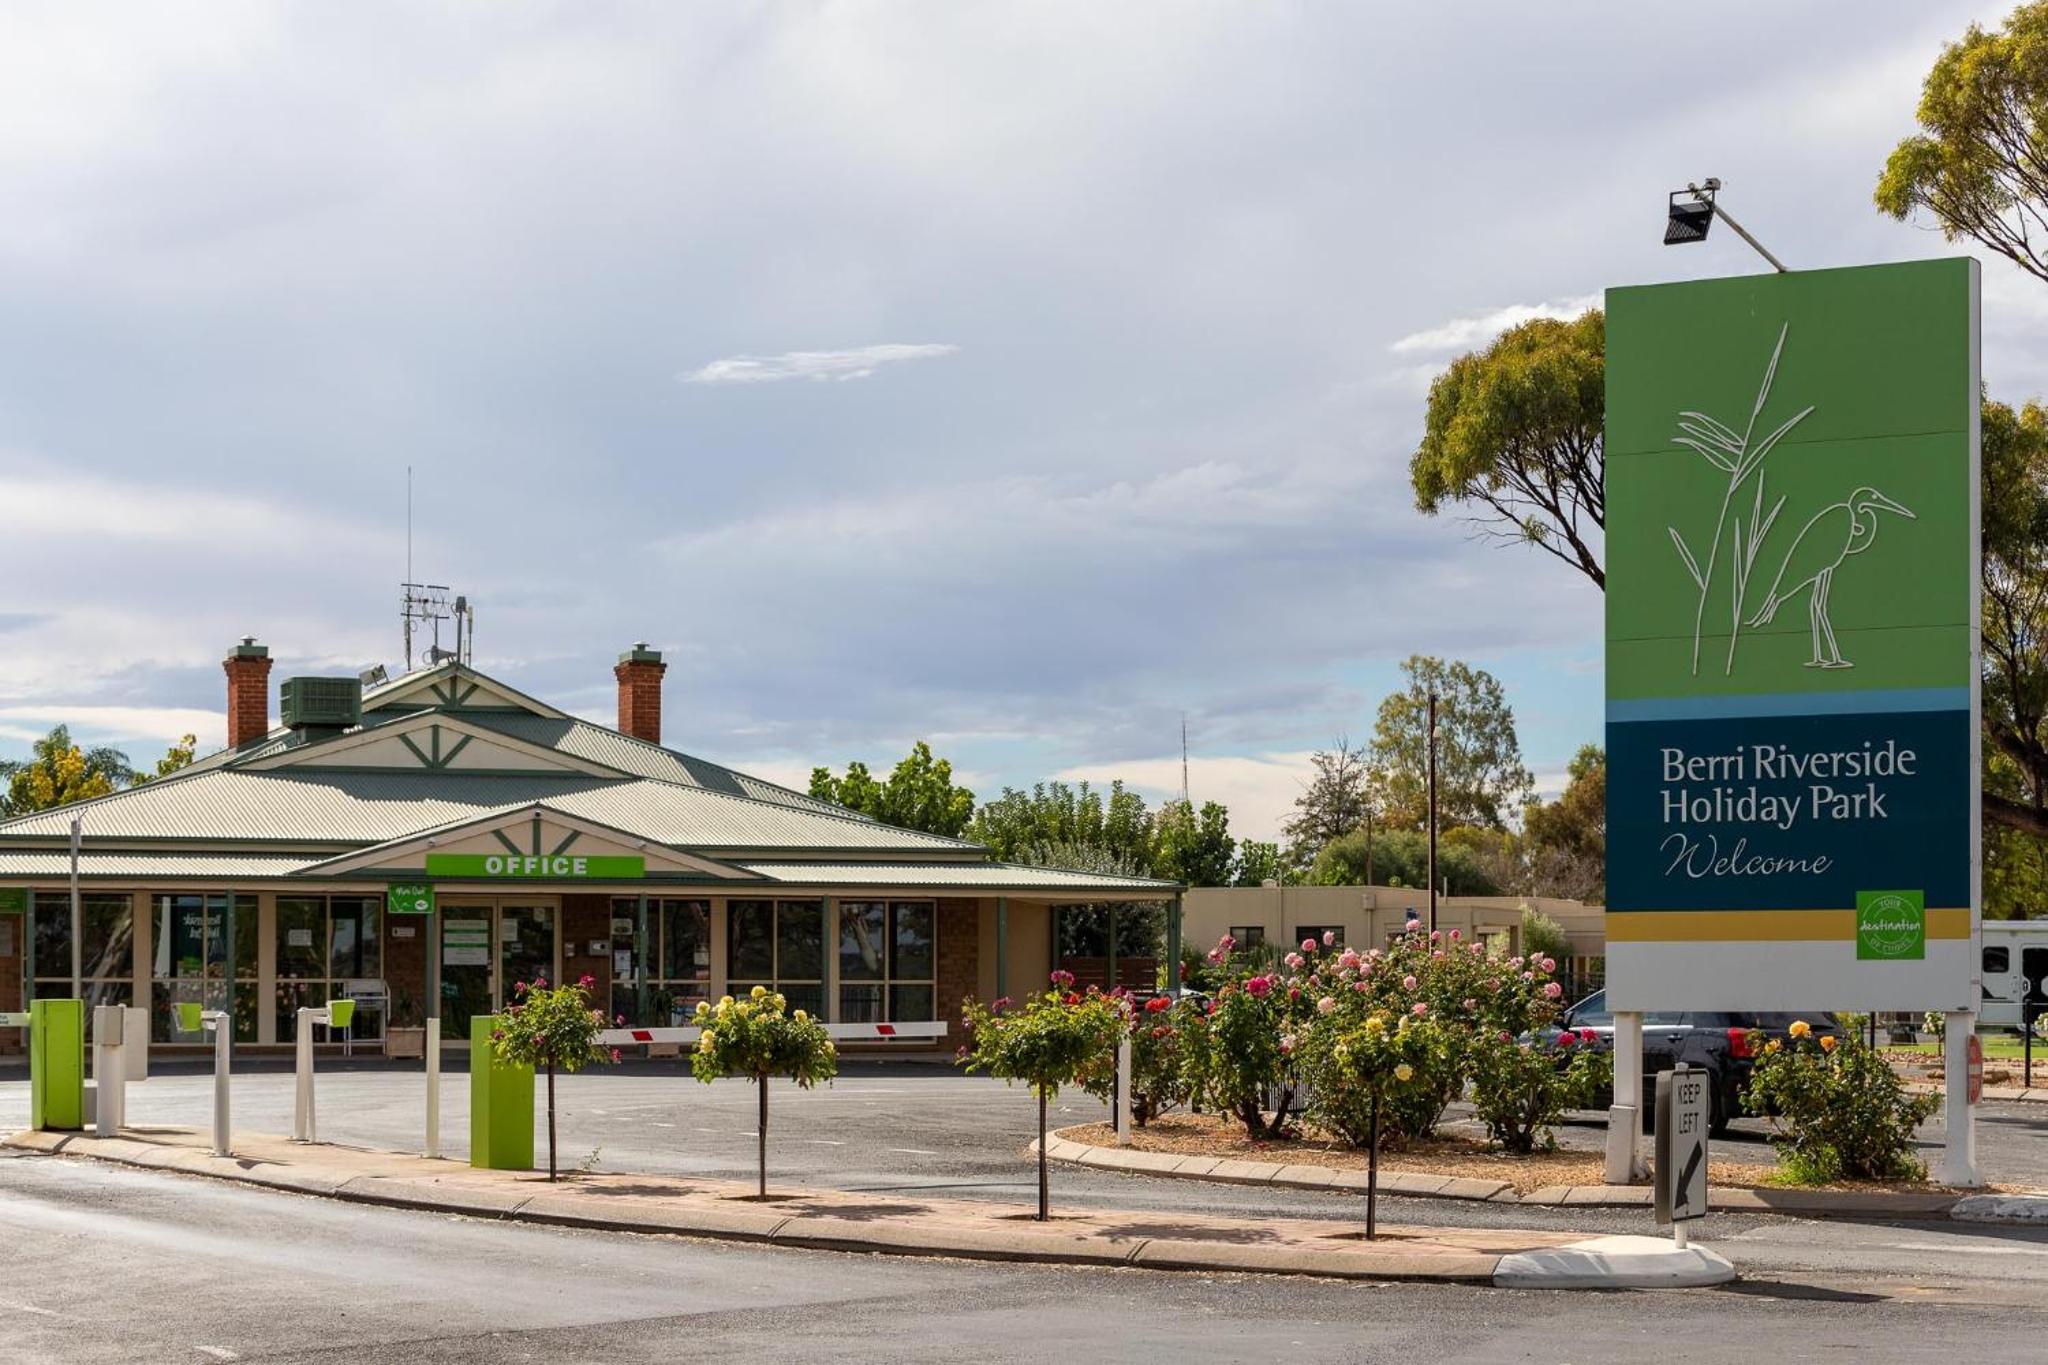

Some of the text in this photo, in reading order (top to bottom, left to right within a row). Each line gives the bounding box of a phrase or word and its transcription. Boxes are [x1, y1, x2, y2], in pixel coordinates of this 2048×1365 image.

[1661, 739, 1917, 782] Berri Riverside
[1661, 783, 1888, 830] Holiday Park
[485, 857, 588, 875] OFFICE
[1660, 833, 1833, 878] Welcome
[1859, 918, 1921, 932] destination
[1678, 1083, 1701, 1105] KEEP
[1679, 1112, 1699, 1134] LEFT
